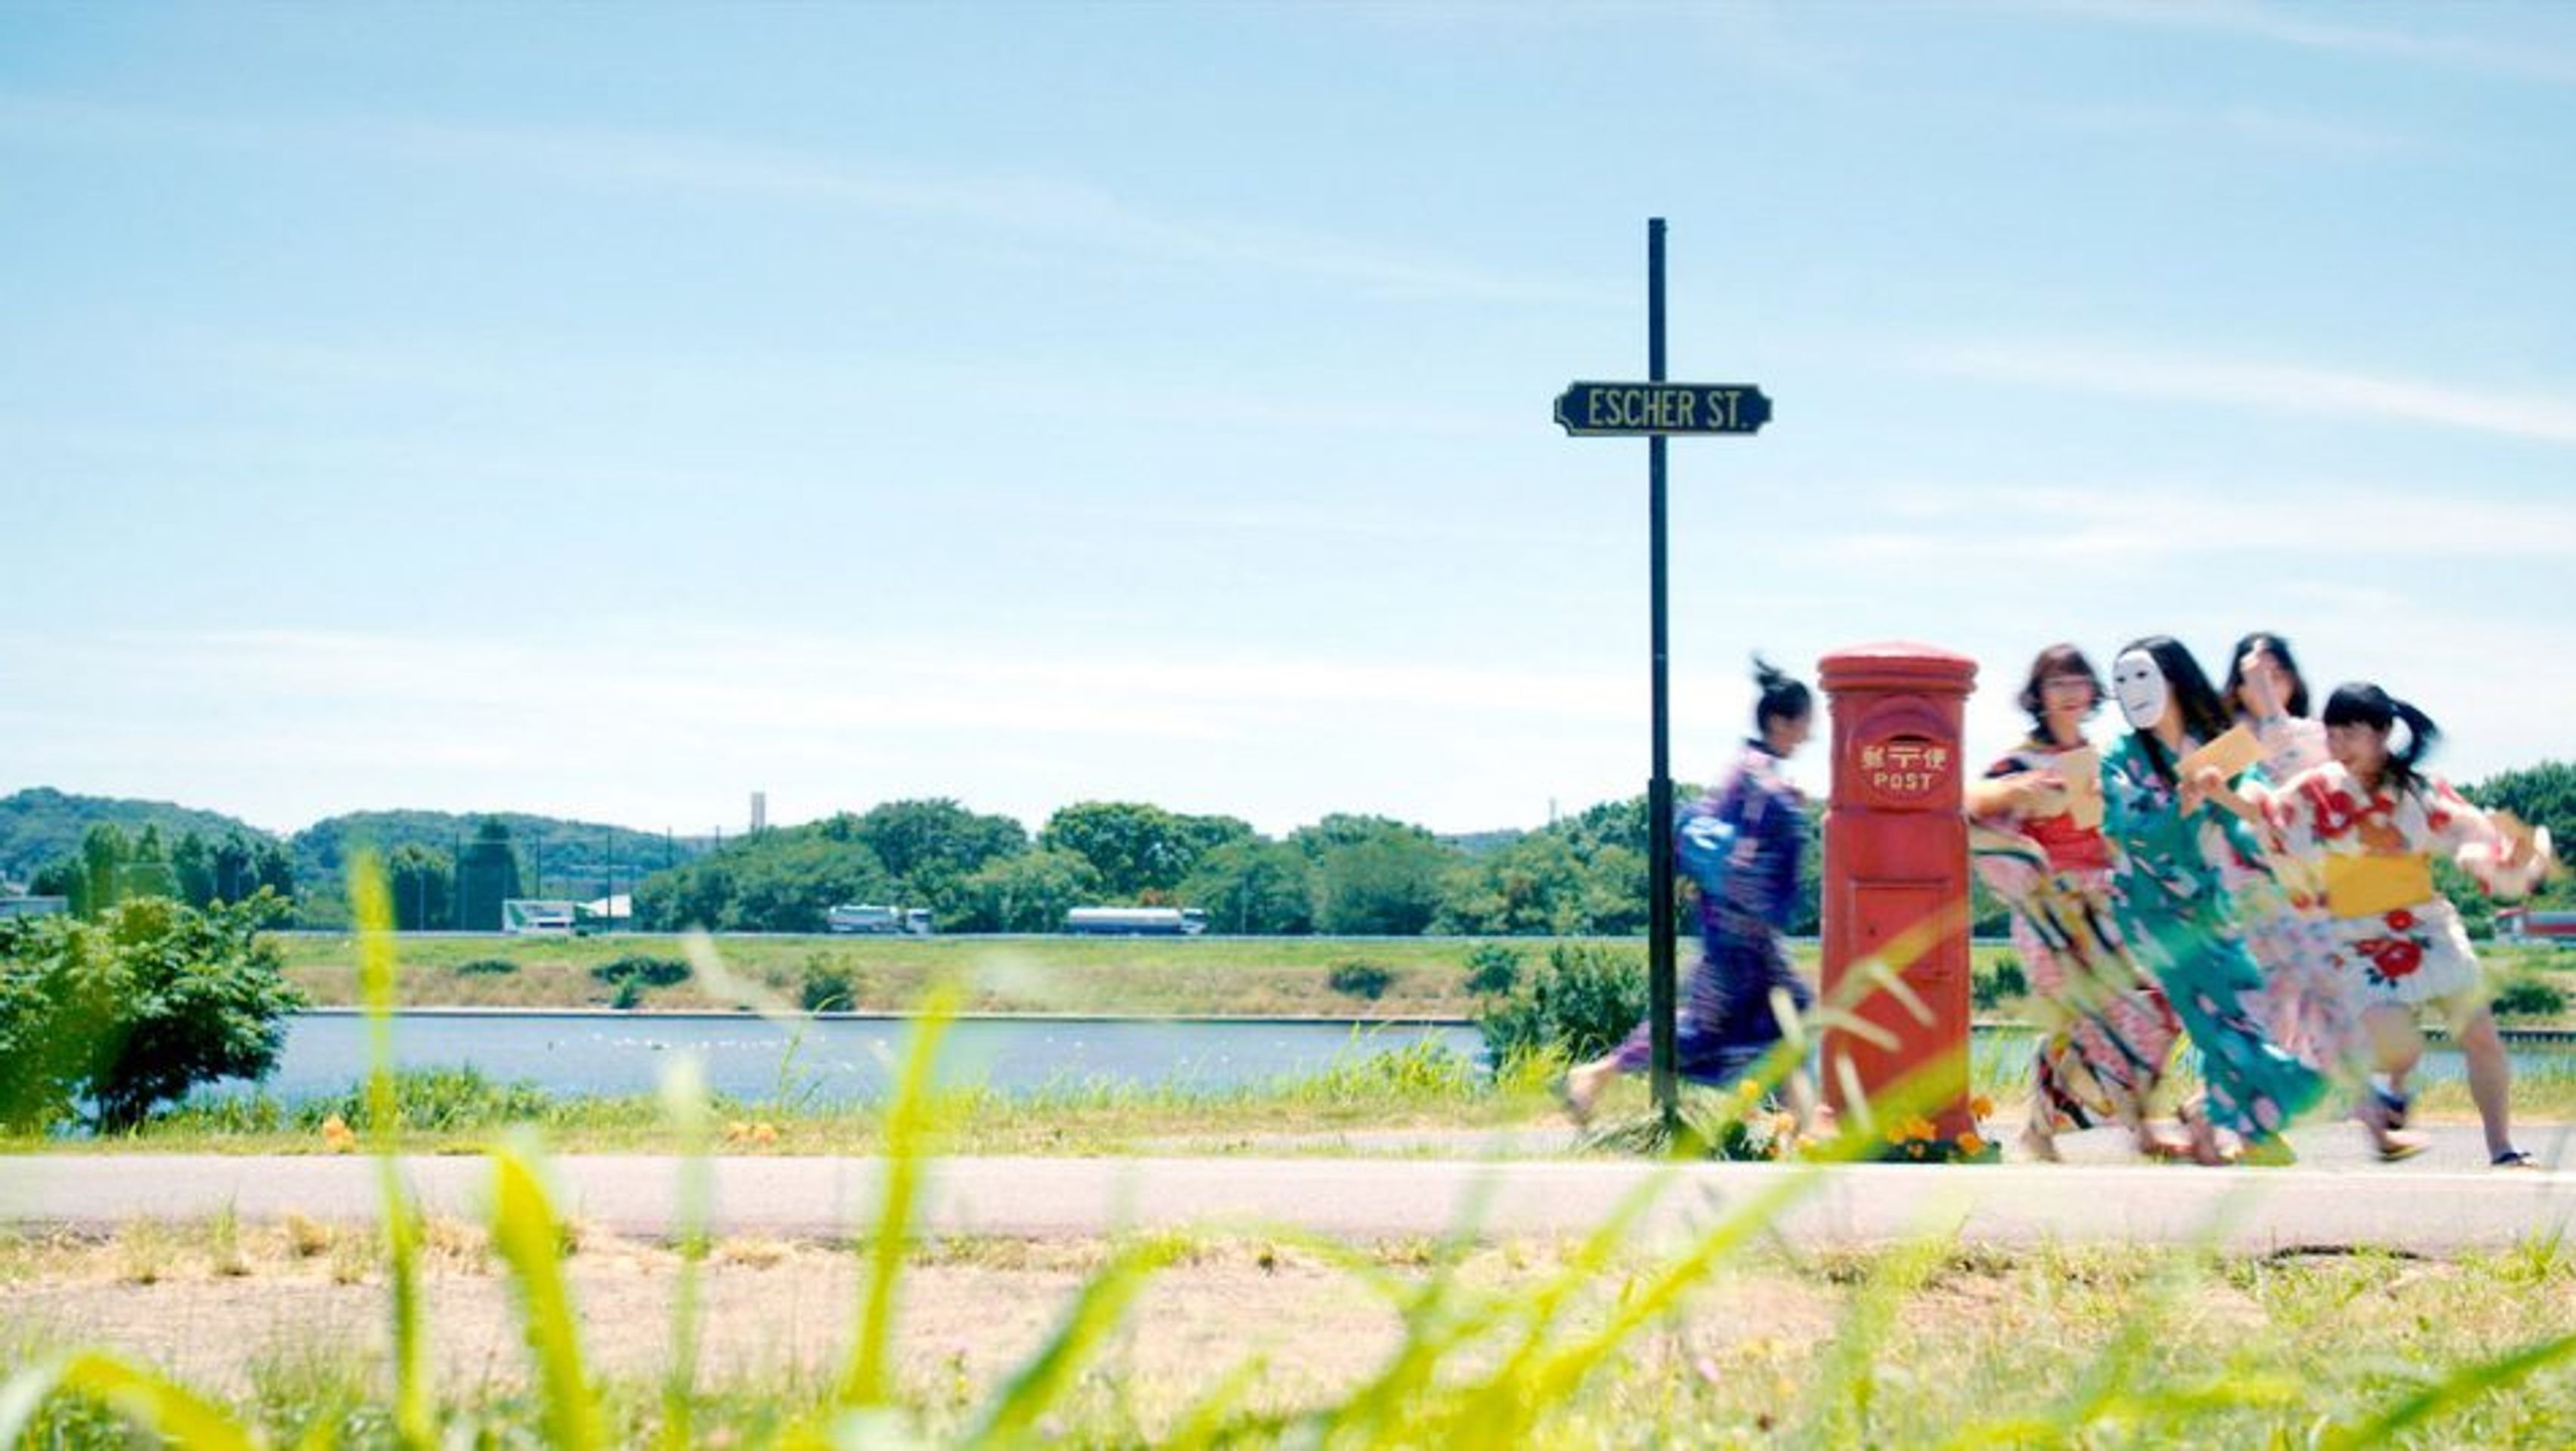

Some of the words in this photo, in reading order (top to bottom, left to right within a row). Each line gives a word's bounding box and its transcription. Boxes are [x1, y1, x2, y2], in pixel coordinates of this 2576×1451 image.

[1588, 388, 1695, 426] ESCHER
[1707, 390, 1749, 428] ST.
[1873, 772, 1934, 790] POST
